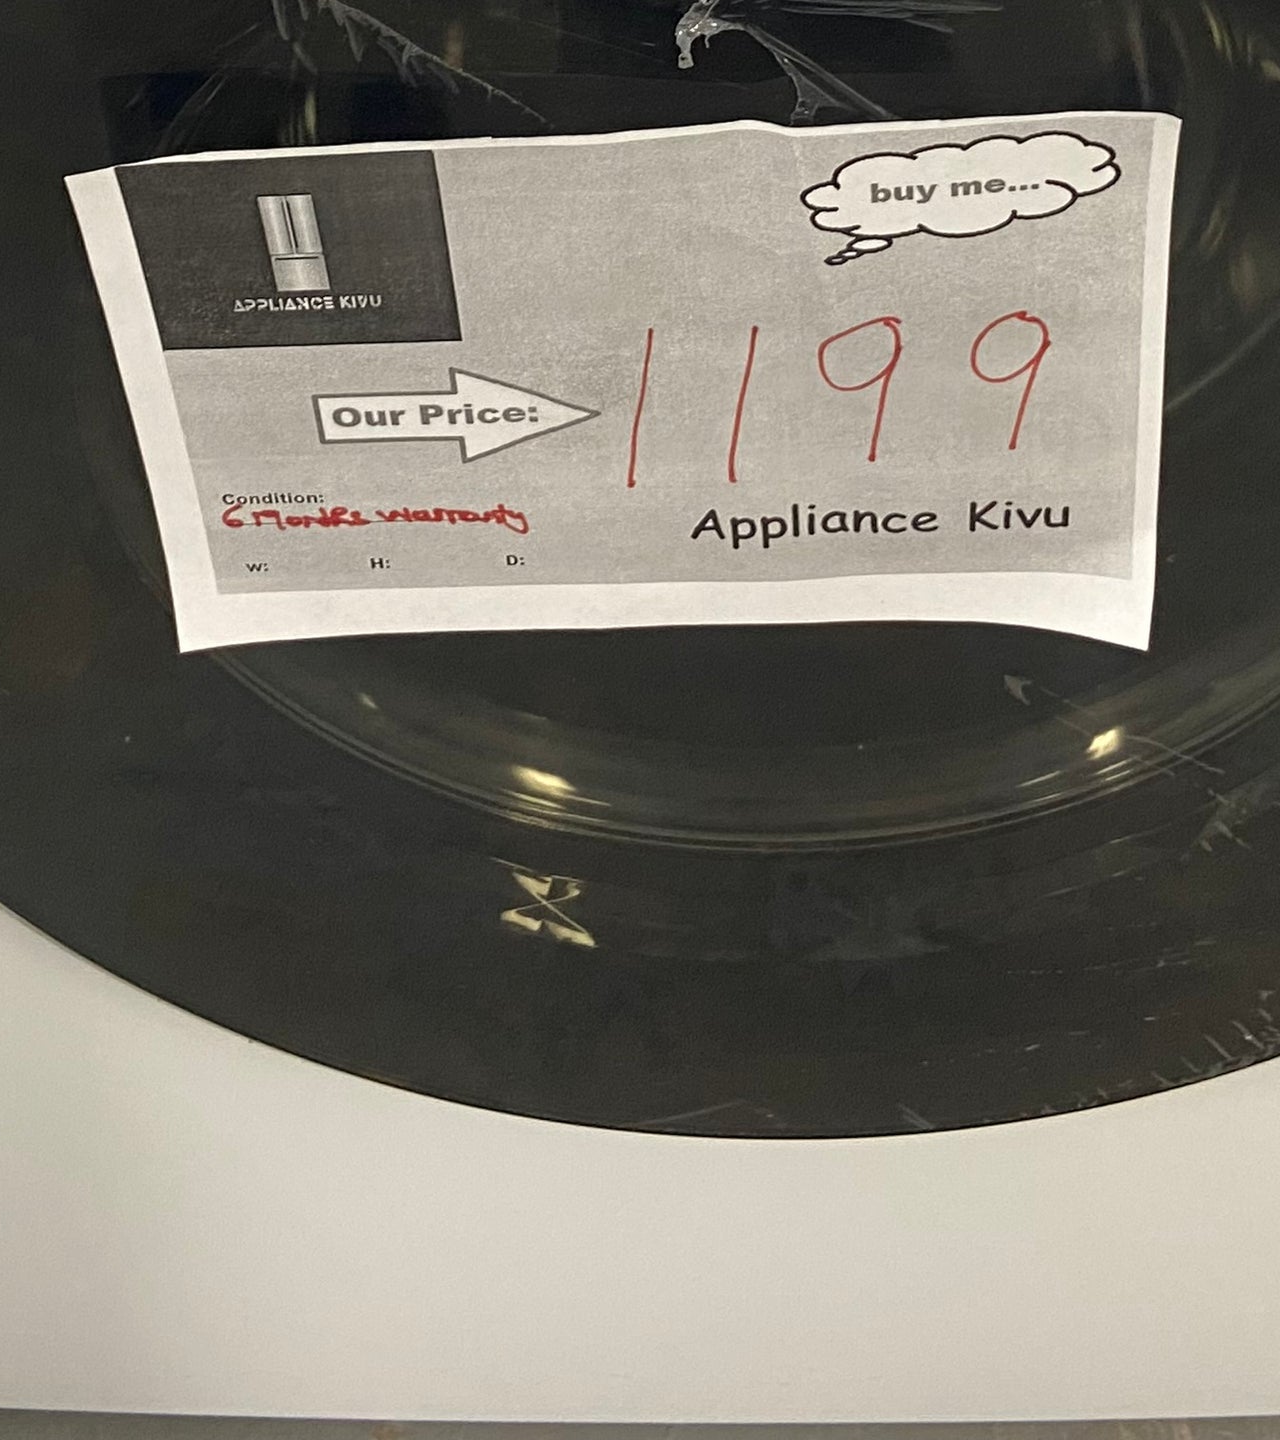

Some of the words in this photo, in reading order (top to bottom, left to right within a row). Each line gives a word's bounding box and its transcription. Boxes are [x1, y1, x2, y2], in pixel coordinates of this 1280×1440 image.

[870, 183, 938, 204] buy
[951, 173, 1041, 198] me...
[233, 295, 336, 312] APPLIANCE
[339, 294, 383, 309] KIVU
[628, 310, 1052, 488] 1199
[332, 407, 406, 428] Our
[419, 404, 540, 426] Price:
[221, 492, 325, 506] Condition:
[222, 502, 245, 528] 6
[690, 502, 940, 551] Appliance
[968, 500, 1071, 532] Kivu
[370, 557, 391, 570] H:
[506, 554, 525, 567] D:
